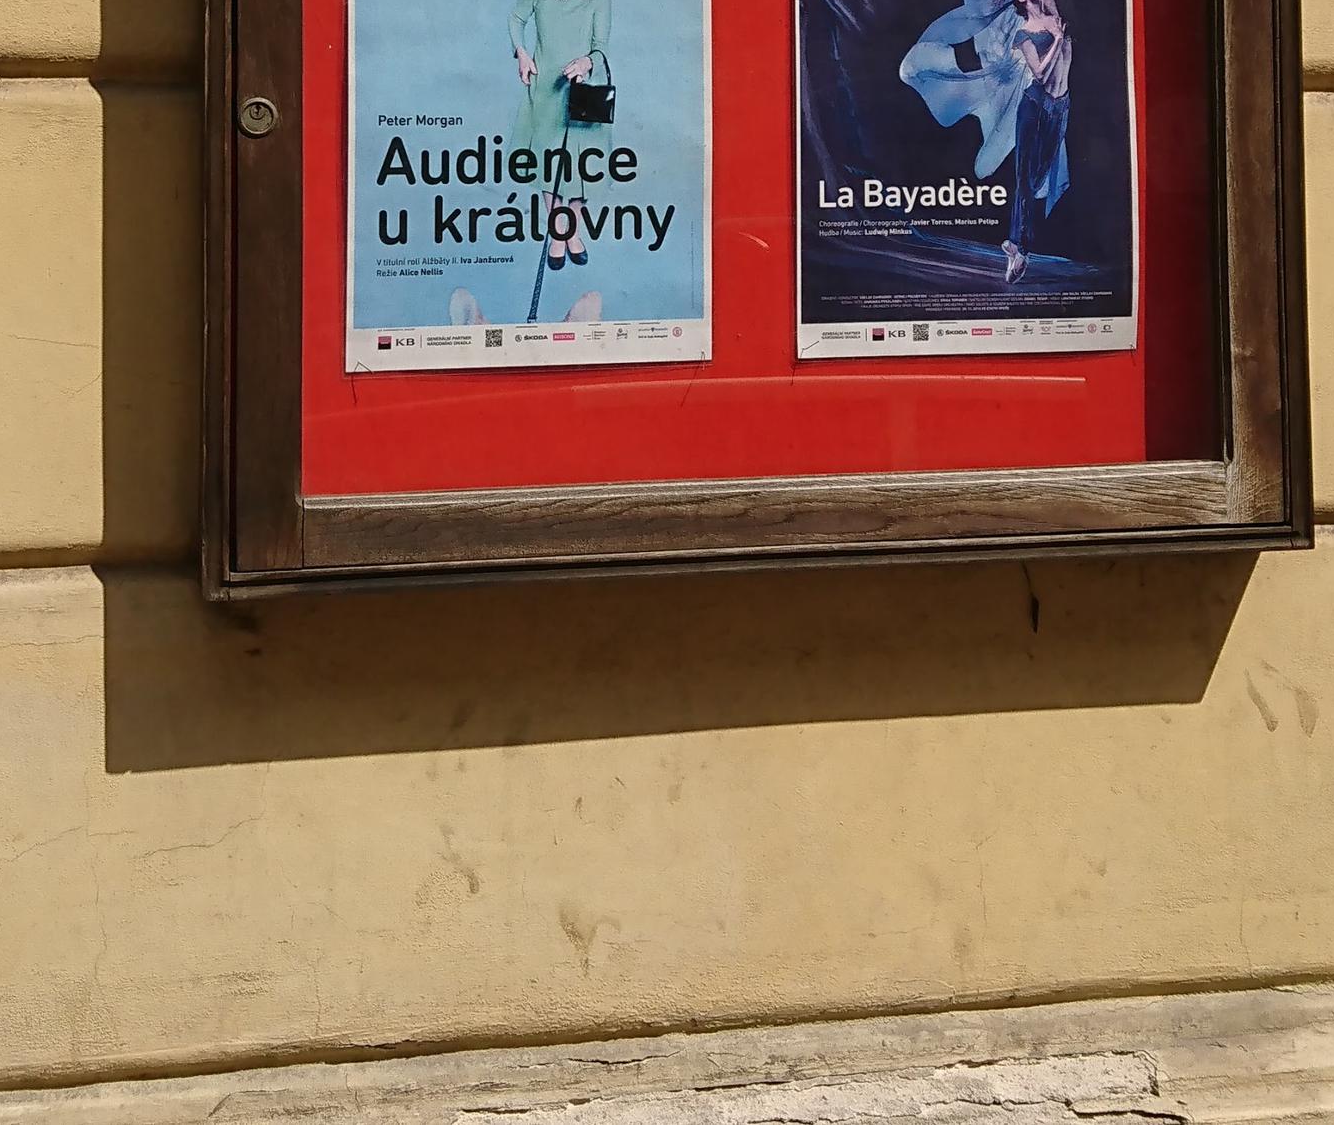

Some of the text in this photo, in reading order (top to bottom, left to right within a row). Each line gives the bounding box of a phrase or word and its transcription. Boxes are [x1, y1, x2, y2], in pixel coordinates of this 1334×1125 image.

[378, 114, 463, 128] Peter Morgan
[376, 135, 638, 186] Audience
[819, 177, 1007, 213] La Bayadère
[378, 192, 676, 252] u královny
[978, 218, 999, 226] Petipa
[819, 229, 839, 237] Hudba
[864, 228, 888, 237] Ludwig
[889, 227, 912, 235] Minkus
[460, 256, 472, 264] Iva
[473, 255, 514, 264] Janžurová
[376, 268, 443, 277] Režie Alice Nellis
[888, 330, 906, 338] KB
[396, 338, 415, 346] KB
